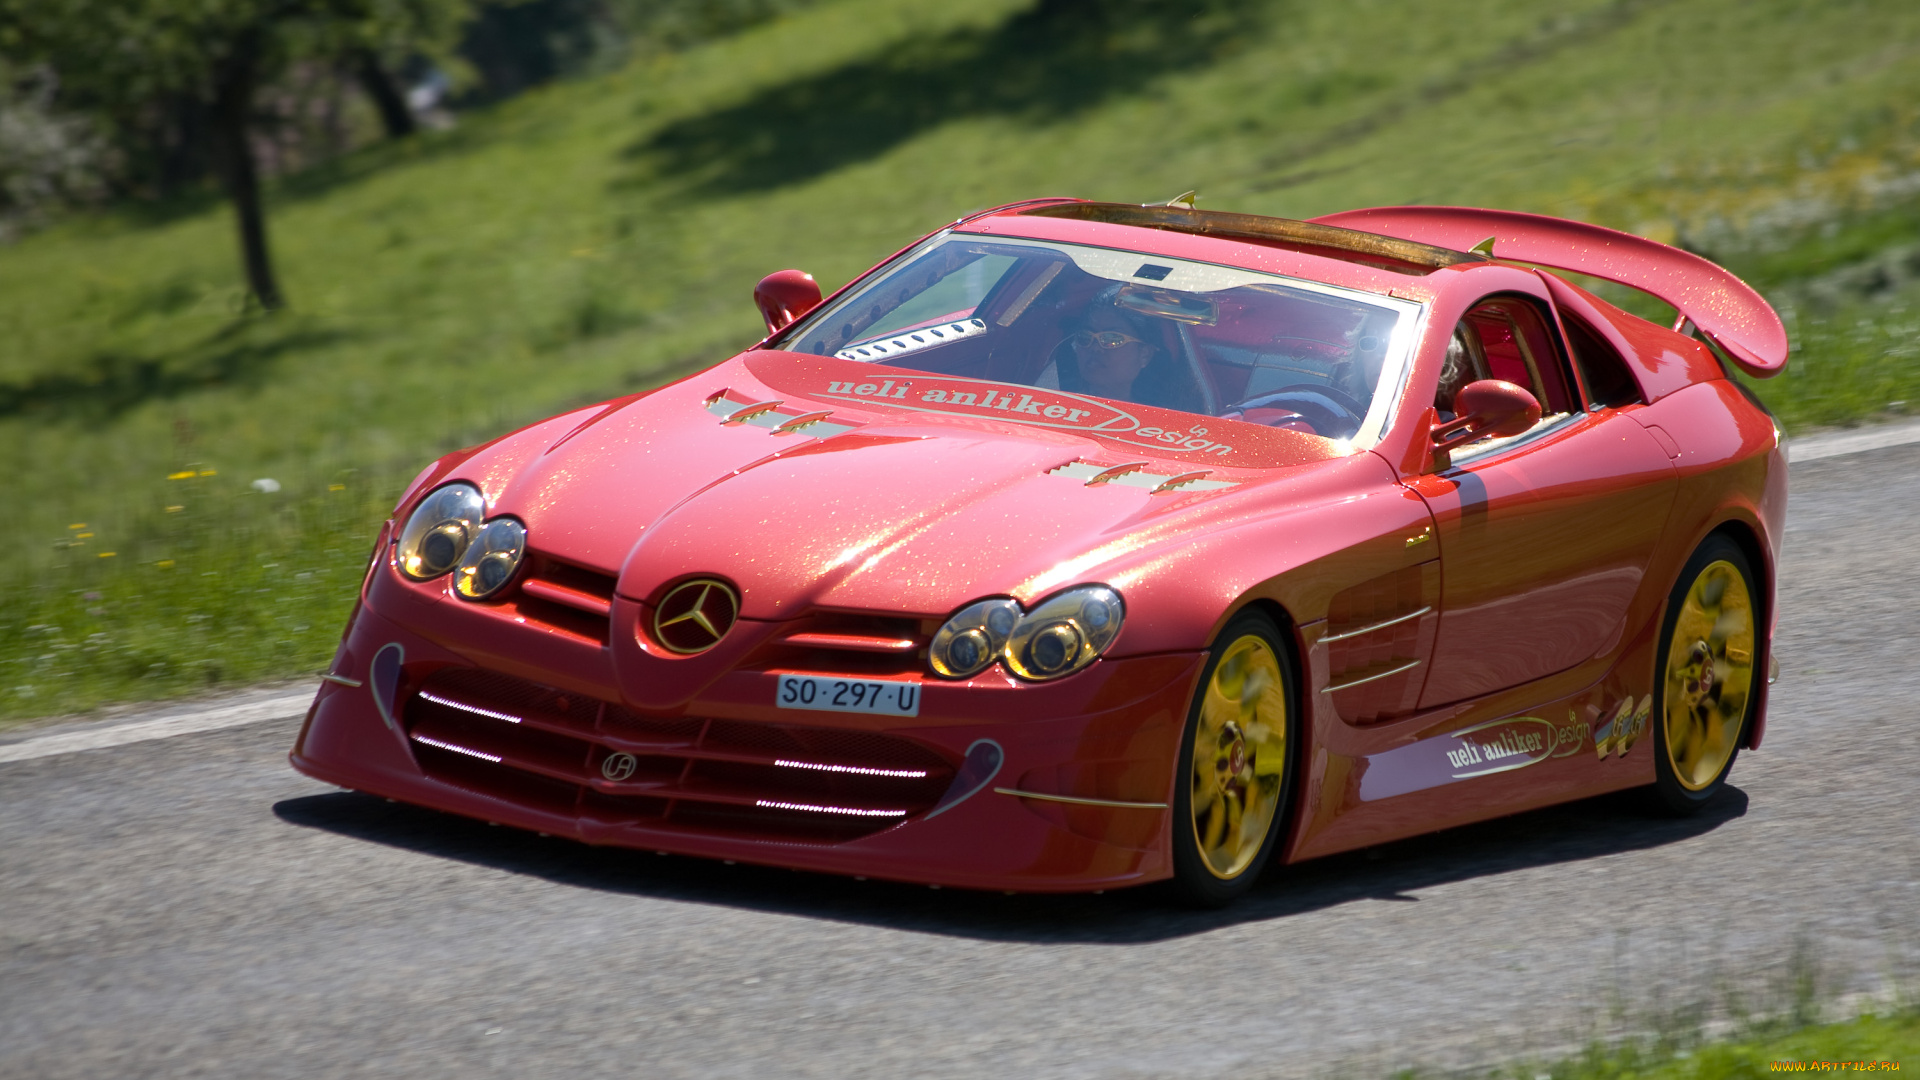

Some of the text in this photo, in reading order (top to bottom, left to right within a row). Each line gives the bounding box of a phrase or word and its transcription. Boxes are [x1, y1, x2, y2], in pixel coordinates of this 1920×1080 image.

[827, 380, 1233, 456] ueli anliker Design
[1446, 719, 1591, 769] ueli anliker Design
